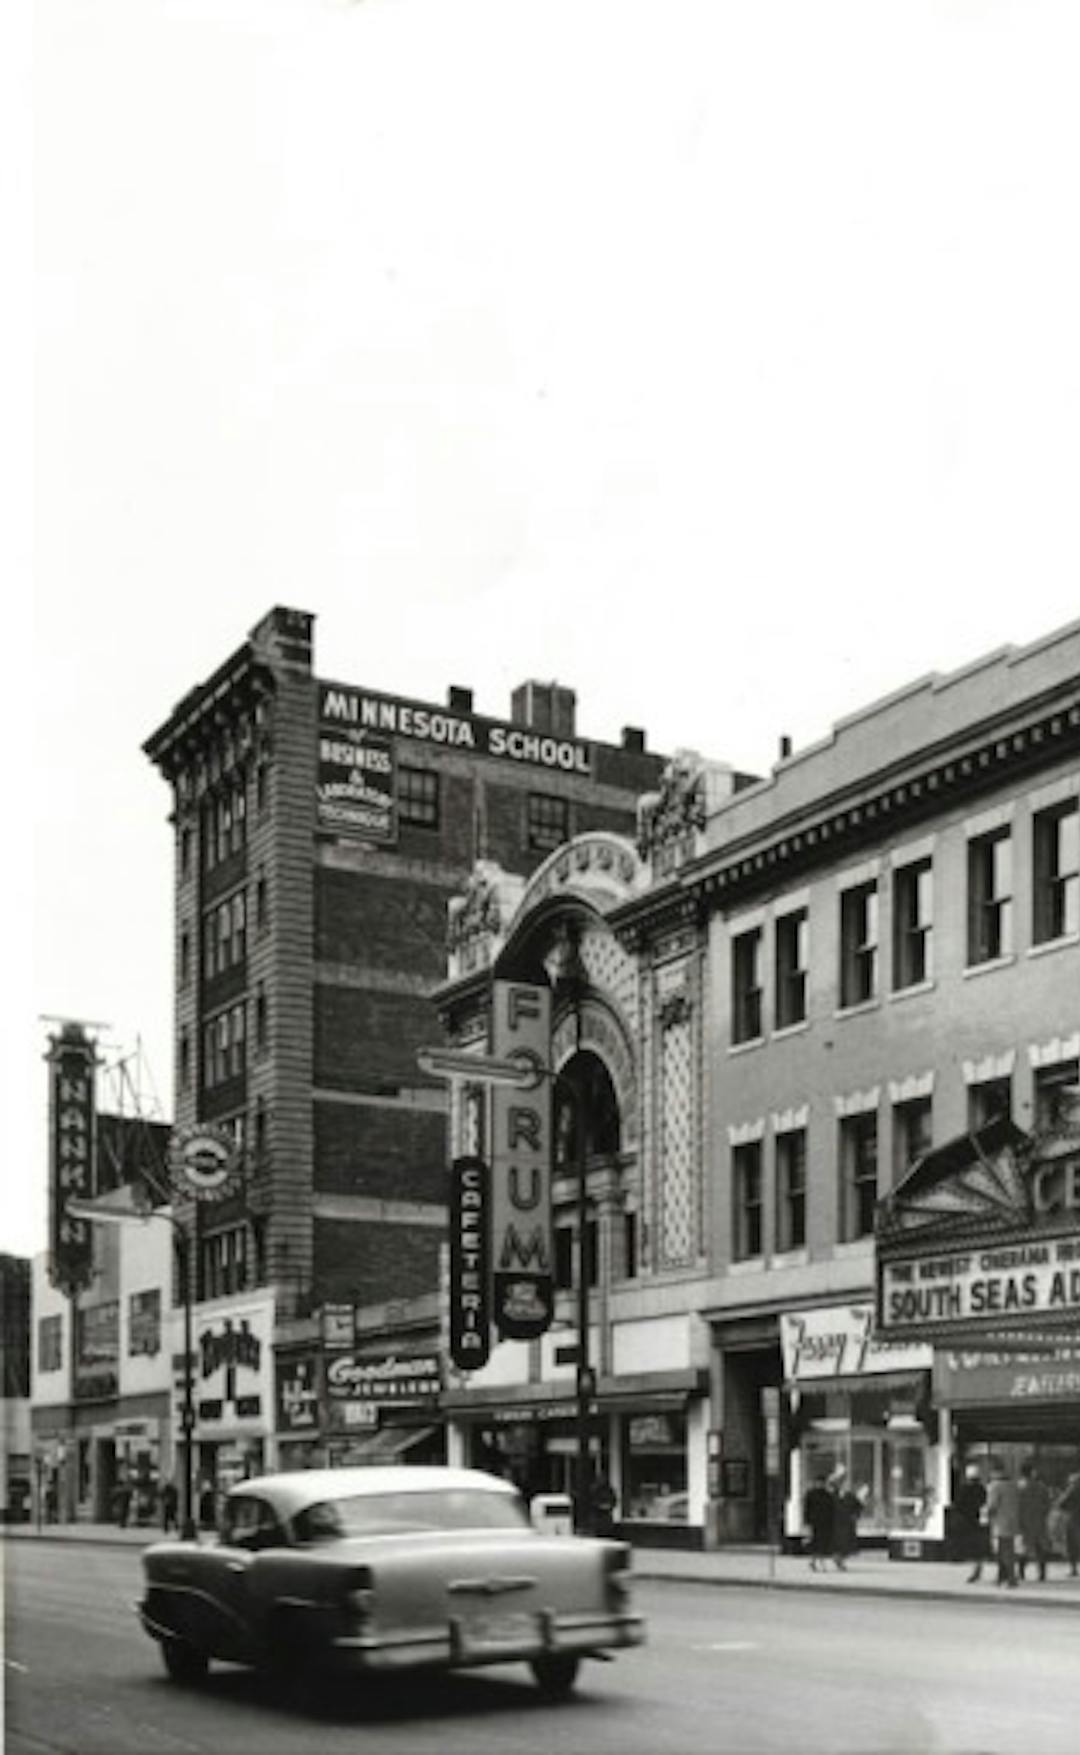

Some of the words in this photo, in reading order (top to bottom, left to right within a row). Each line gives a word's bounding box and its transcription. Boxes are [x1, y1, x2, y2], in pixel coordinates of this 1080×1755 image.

[319, 739, 392, 774] BUSINESS
[324, 690, 476, 748] MINNESOTA
[488, 727, 592, 773] SCHOOL
[59, 1076, 87, 1244] NANKN
[501, 986, 547, 1270] FORUM
[460, 1169, 482, 1349] CAFETERIA
[889, 1285, 961, 1322] SOUTH
[969, 1274, 1037, 1312] SEAS
[979, 1246, 1049, 1271] CINERAMA
